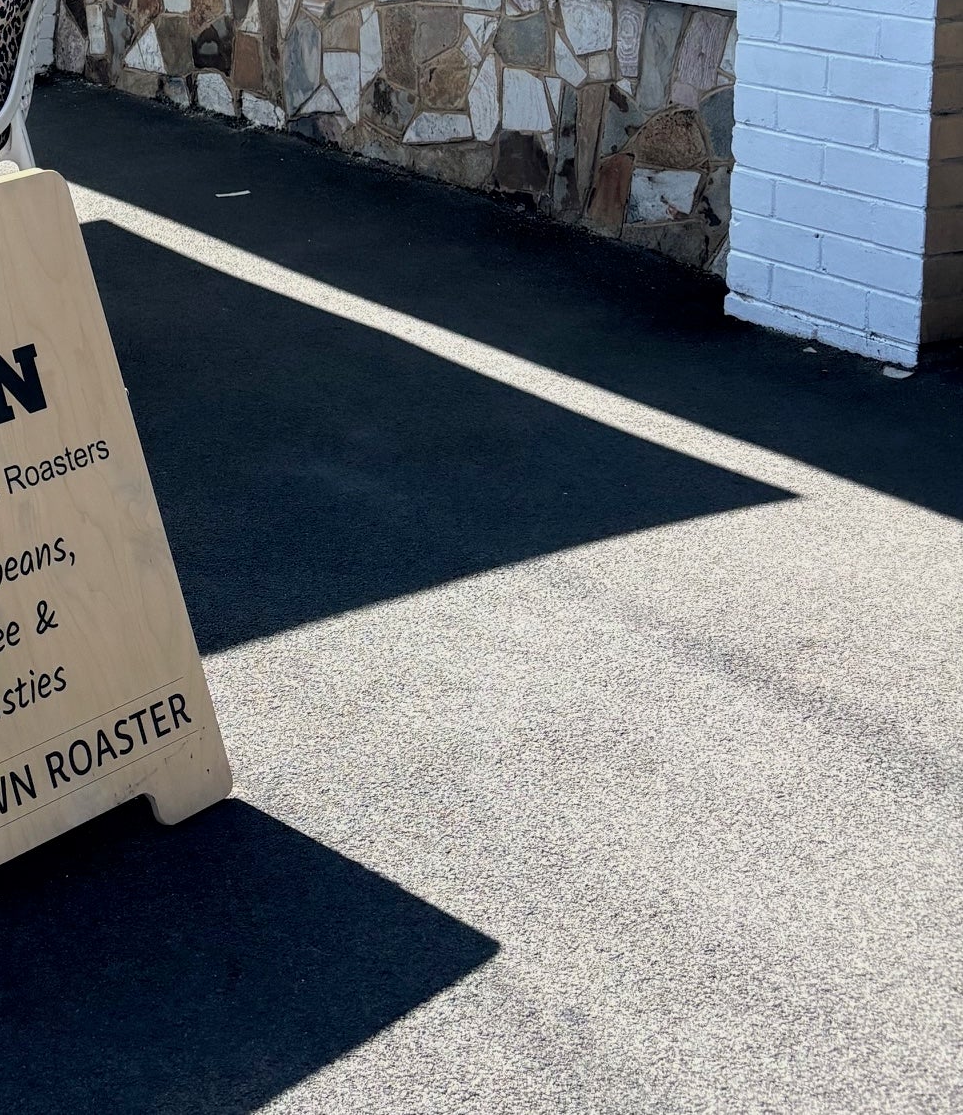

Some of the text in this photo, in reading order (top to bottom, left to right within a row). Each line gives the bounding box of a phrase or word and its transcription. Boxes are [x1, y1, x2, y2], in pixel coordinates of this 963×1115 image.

[3, 439, 111, 494] Roasters
[35, 599, 60, 635] &
[44, 692, 193, 788] ROASTER
